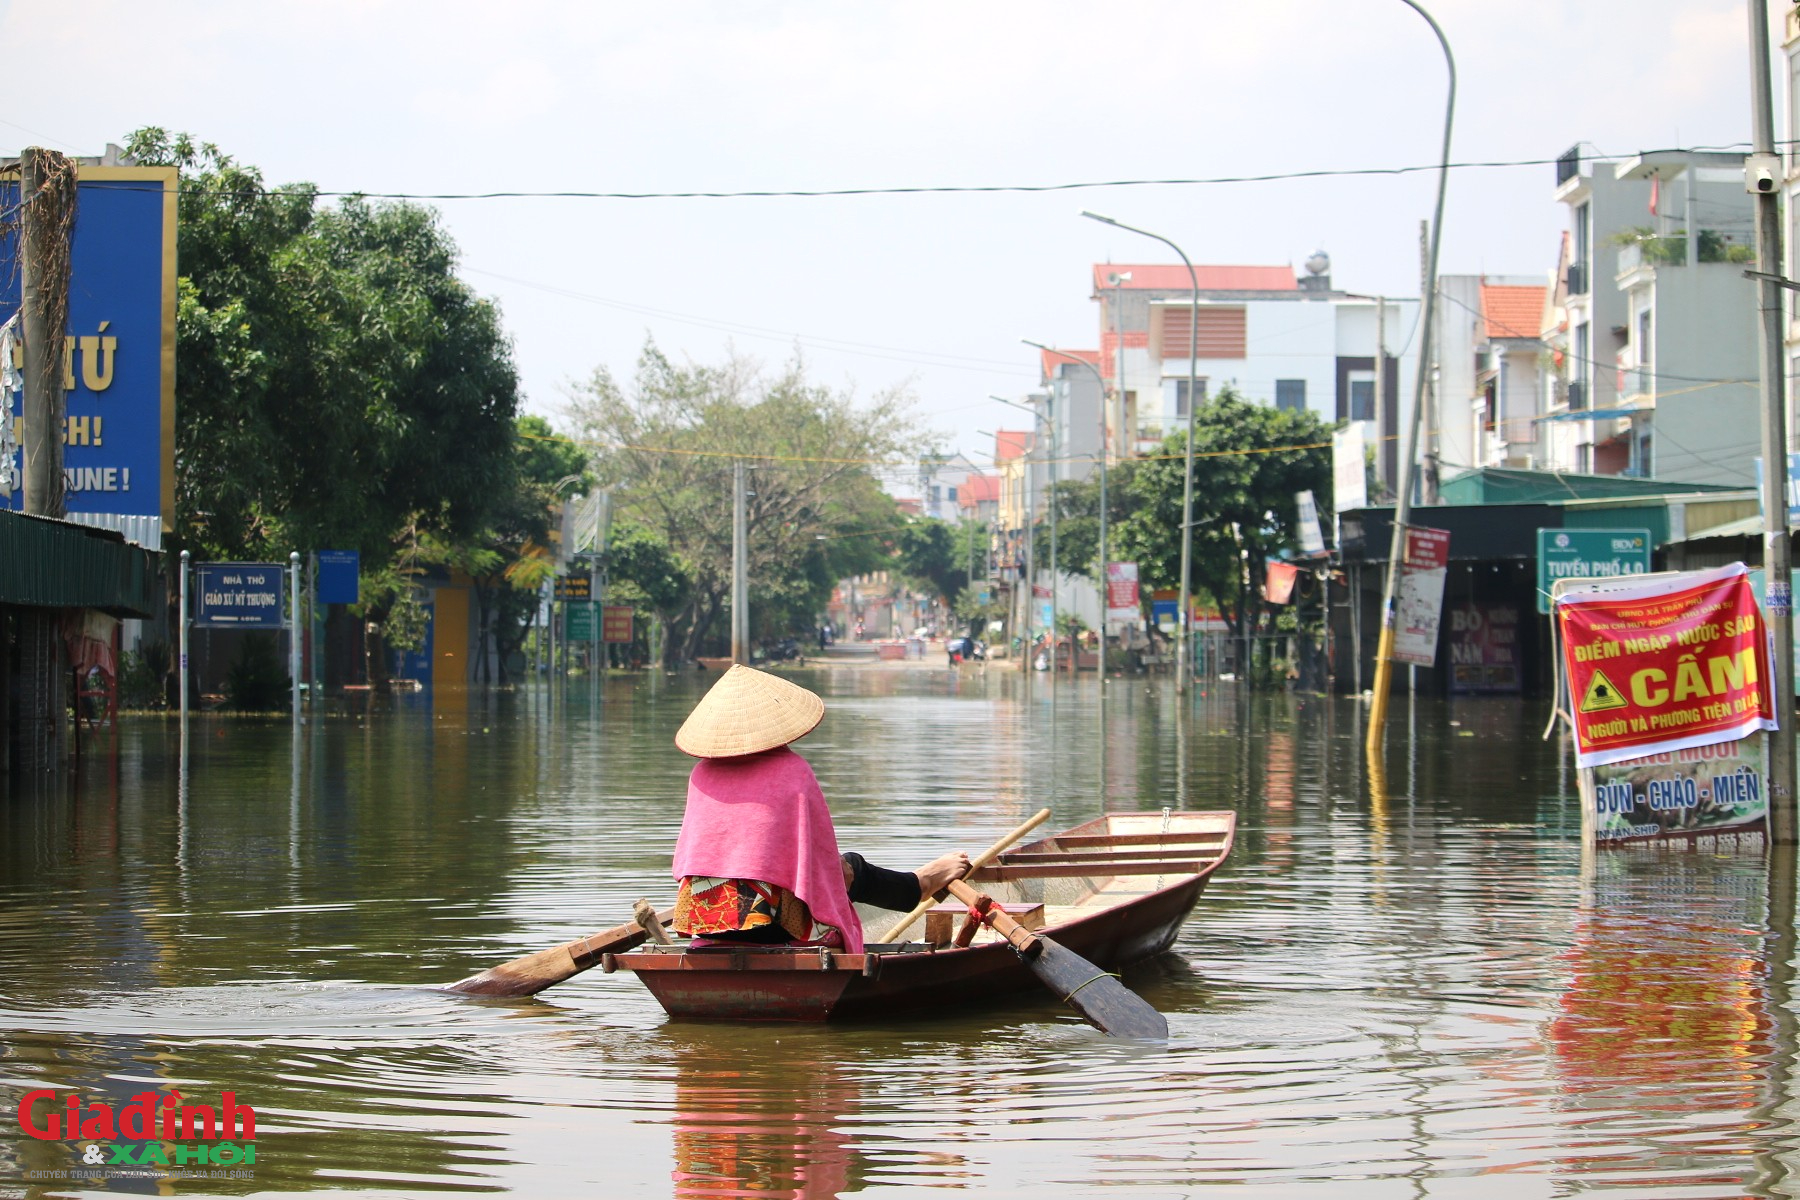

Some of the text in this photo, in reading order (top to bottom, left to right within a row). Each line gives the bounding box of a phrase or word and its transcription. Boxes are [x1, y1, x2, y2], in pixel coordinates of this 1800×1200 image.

[223, 574, 266, 585] NHÀ THỜ
[1547, 557, 1590, 577] TUYẾN
[1593, 557, 1621, 576] PHỐ
[205, 588, 223, 606] GIÁO
[235, 588, 246, 606] MỸ
[246, 590, 276, 608] THƯỢNG
[1617, 609, 1644, 618] UBND
[1647, 607, 1660, 616] XÃ
[1662, 602, 1684, 613] TRẦN
[1590, 623, 1610, 632] BAN
[1610, 621, 1627, 630] CHỈ
[1627, 620, 1647, 629] HUY
[1648, 614, 1680, 627] PHÒNG
[1701, 602, 1722, 614] DÂN
[1575, 614, 1756, 663] ĐIỂM NGẬP NƯỚC SÂU
[1630, 646, 1758, 708] CẤM
[1587, 691, 1762, 740] NGƯỜI VÀ PHƯƠNG TIỆN ĐI LẠI
[1595, 778, 1634, 815] BÚN
[1649, 772, 1698, 811] CHÁO
[1713, 764, 1761, 805] MIẾN
